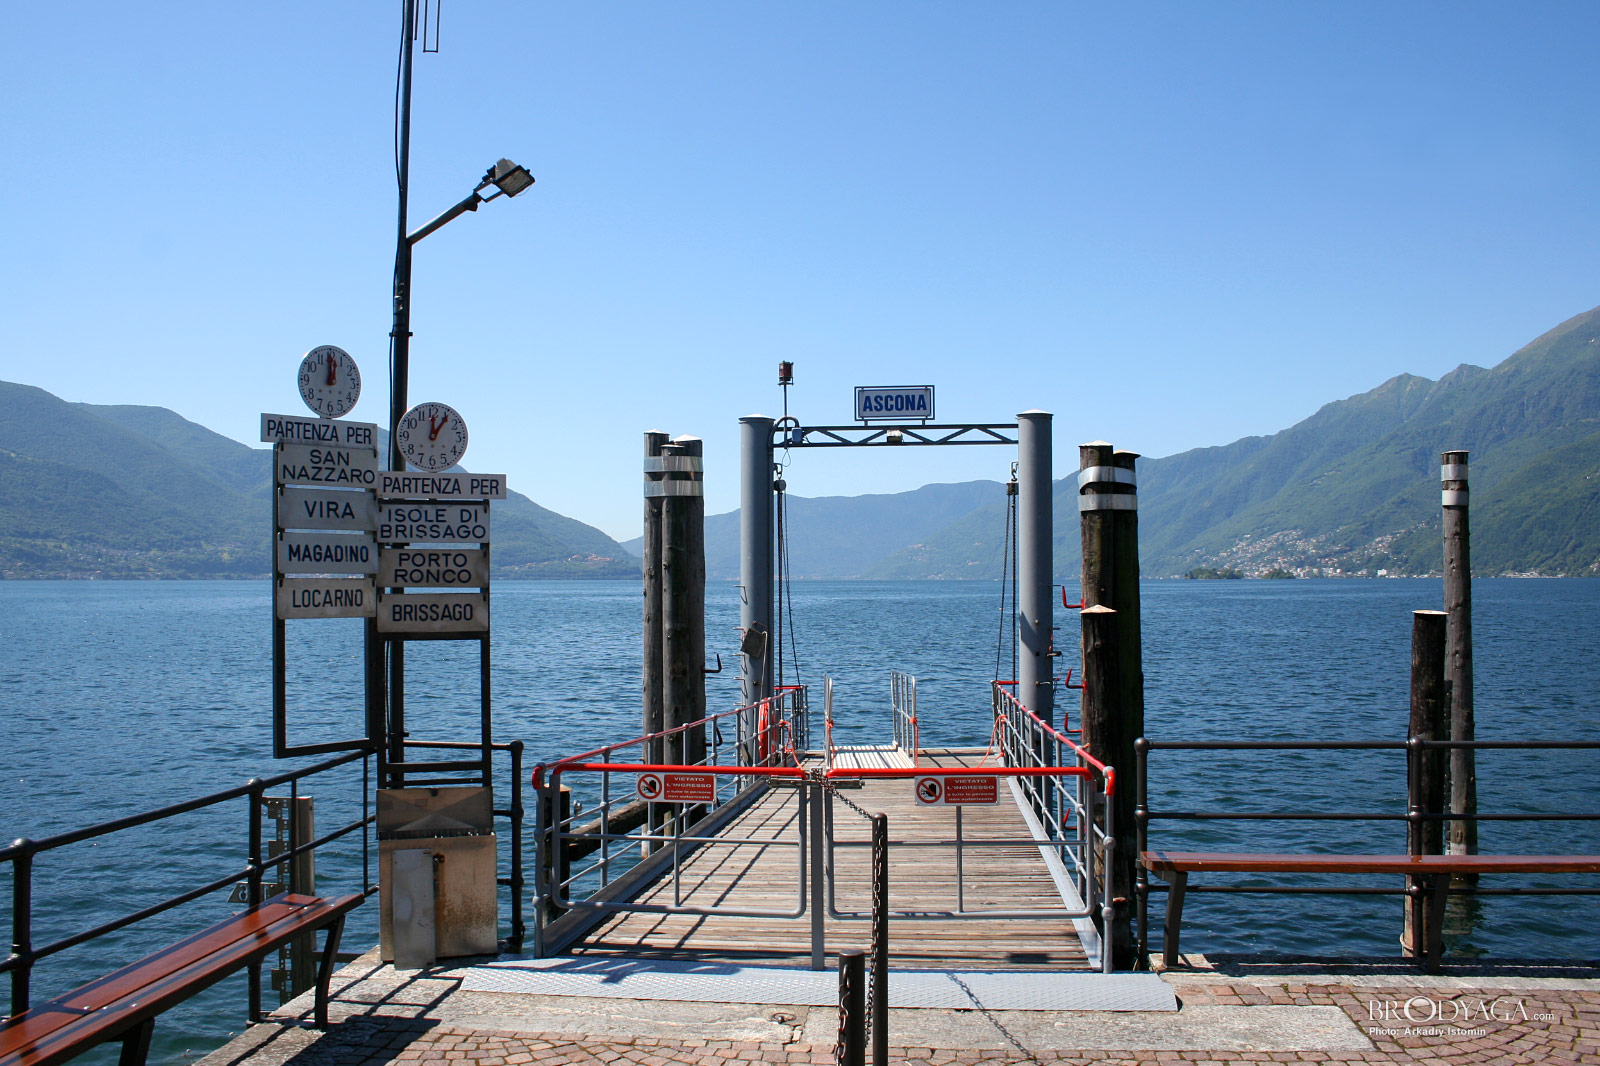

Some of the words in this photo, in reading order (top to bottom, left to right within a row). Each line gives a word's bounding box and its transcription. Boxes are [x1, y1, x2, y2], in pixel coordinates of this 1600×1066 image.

[317, 354, 323, 365] 11
[307, 361, 317, 373] 10
[346, 365, 352, 376] 2
[304, 374, 310, 386] 9
[351, 378, 356, 390] 3
[308, 388, 314, 400] 8
[346, 392, 352, 403] 4
[316, 398, 323, 410] 7
[327, 400, 334, 412] 6
[337, 400, 343, 412] 5
[863, 394, 927, 412] ASCONA
[418, 411, 425, 422] 11
[428, 408, 439, 419] 12
[406, 418, 418, 430] 10
[451, 420, 458, 430] 2
[267, 420, 339, 442] PARTENZA
[347, 426, 372, 444] PER
[402, 431, 410, 442] 9
[456, 432, 462, 443] 3
[408, 444, 414, 455] 8
[450, 445, 458, 456] 4
[310, 450, 350, 466] SAN
[418, 453, 424, 464] 7
[429, 455, 436, 466] 6
[440, 454, 448, 464] 5
[282, 464, 375, 484] NAZZARO
[383, 476, 462, 494] PARTENZA
[470, 478, 499, 494] PER
[304, 500, 355, 519] VIRA
[388, 508, 446, 522] ISOLE
[460, 509, 478, 522] DI
[380, 524, 486, 538] BRISSAGO
[288, 544, 369, 562] MAGADINO
[398, 553, 468, 567] PORTO
[394, 569, 472, 583] RONCO
[292, 589, 364, 608] LOCARNO
[392, 604, 474, 622] BRISSAGO
